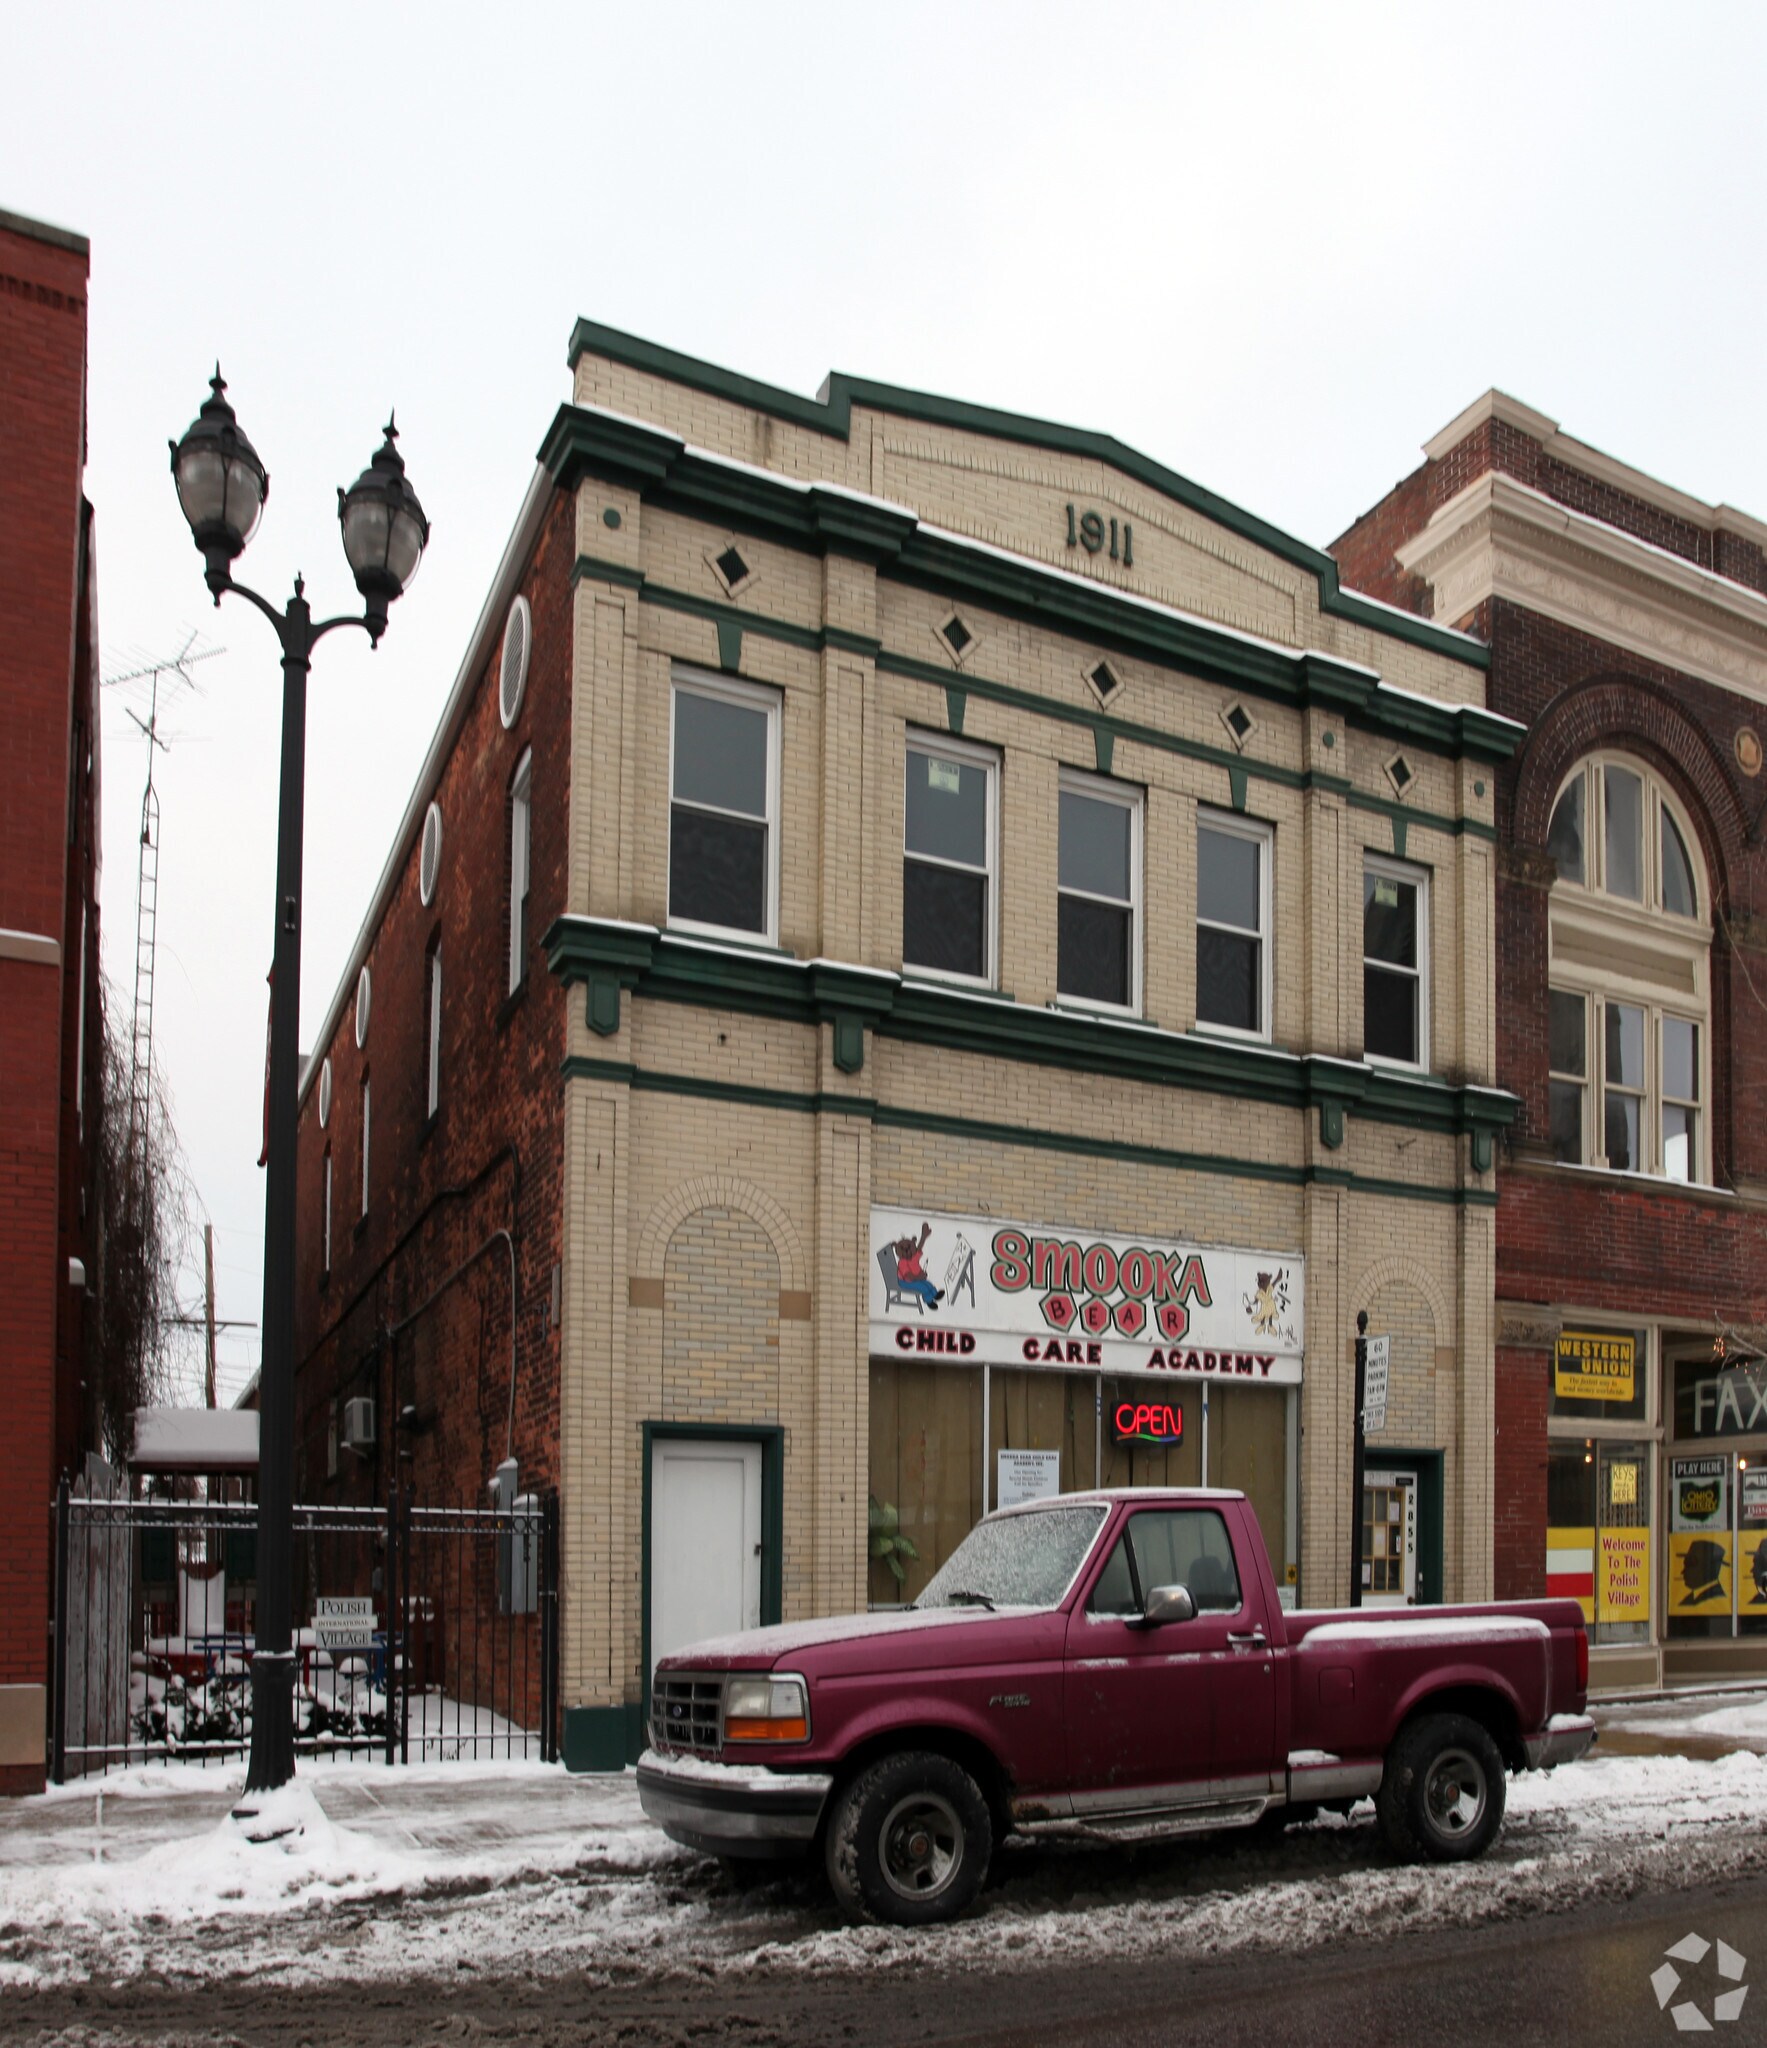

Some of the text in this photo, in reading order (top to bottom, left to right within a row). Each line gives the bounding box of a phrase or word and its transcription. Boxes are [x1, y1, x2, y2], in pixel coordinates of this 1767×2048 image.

[1066, 503, 1133, 568] 1911
[895, 1326, 1276, 1377] CHILD CARE ACADEMY
[1374, 1342, 1383, 1354] 60
[1558, 1340, 1630, 1360] WESTERN
[1581, 1358, 1630, 1377] UNION
[1695, 1375, 1767, 1432] FAX
[1115, 1403, 1182, 1436] OPEN
[1613, 1466, 1634, 1481] KEYS
[1677, 1460, 1721, 1475] PLAY HERE
[1687, 1490, 1714, 1501] OHIO
[1602, 1537, 1645, 1551] Welcome
[1607, 1555, 1641, 1569] To The
[1610, 1573, 1638, 1587] Polish
[1607, 1592, 1640, 1607] Village
[321, 1600, 367, 1615] POLISH
[320, 1631, 369, 1648] VILLAGE
